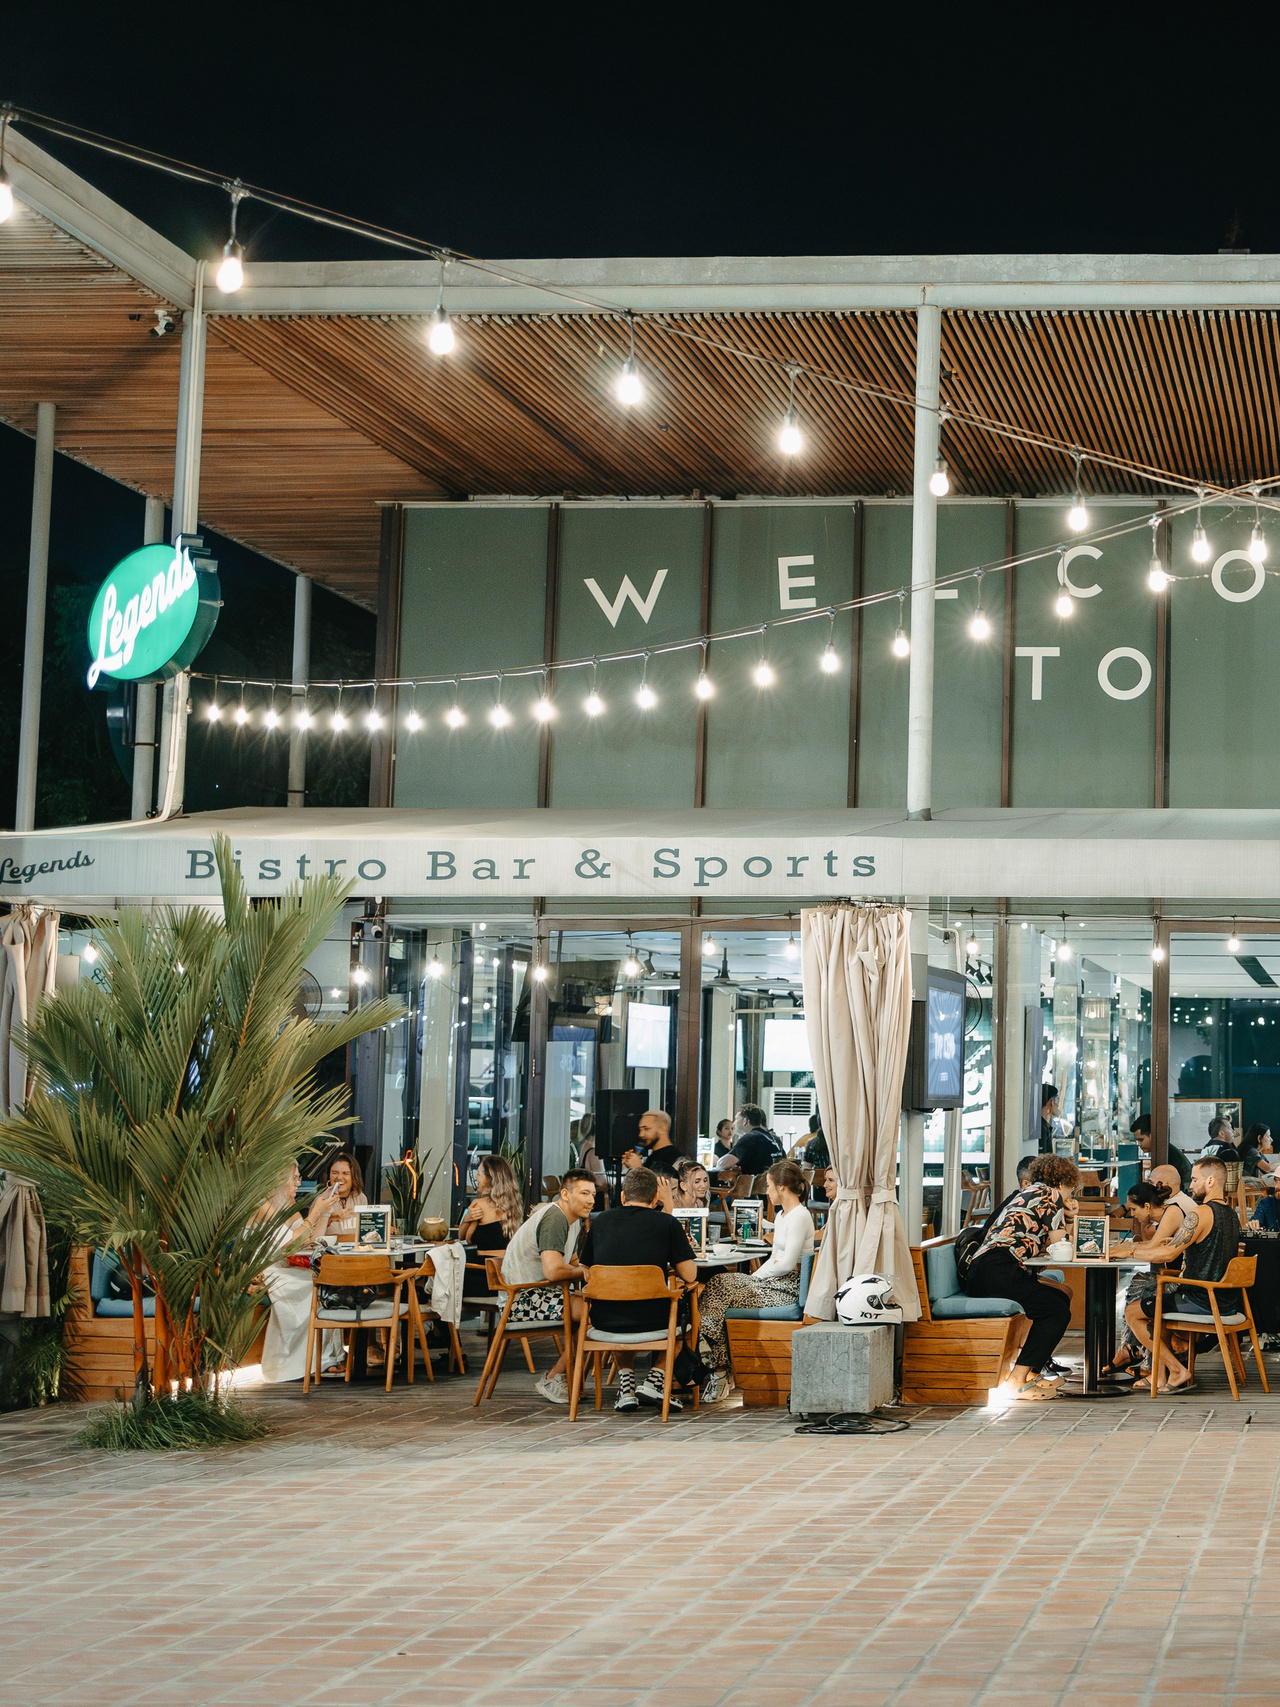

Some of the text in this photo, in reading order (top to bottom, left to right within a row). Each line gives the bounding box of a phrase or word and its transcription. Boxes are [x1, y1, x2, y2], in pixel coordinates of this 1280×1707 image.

[87, 534, 197, 691] Legends
[1015, 646, 1153, 702] TO
[0, 850, 95, 885] Legends
[184, 848, 876, 887] Bistro Bar & Sports
